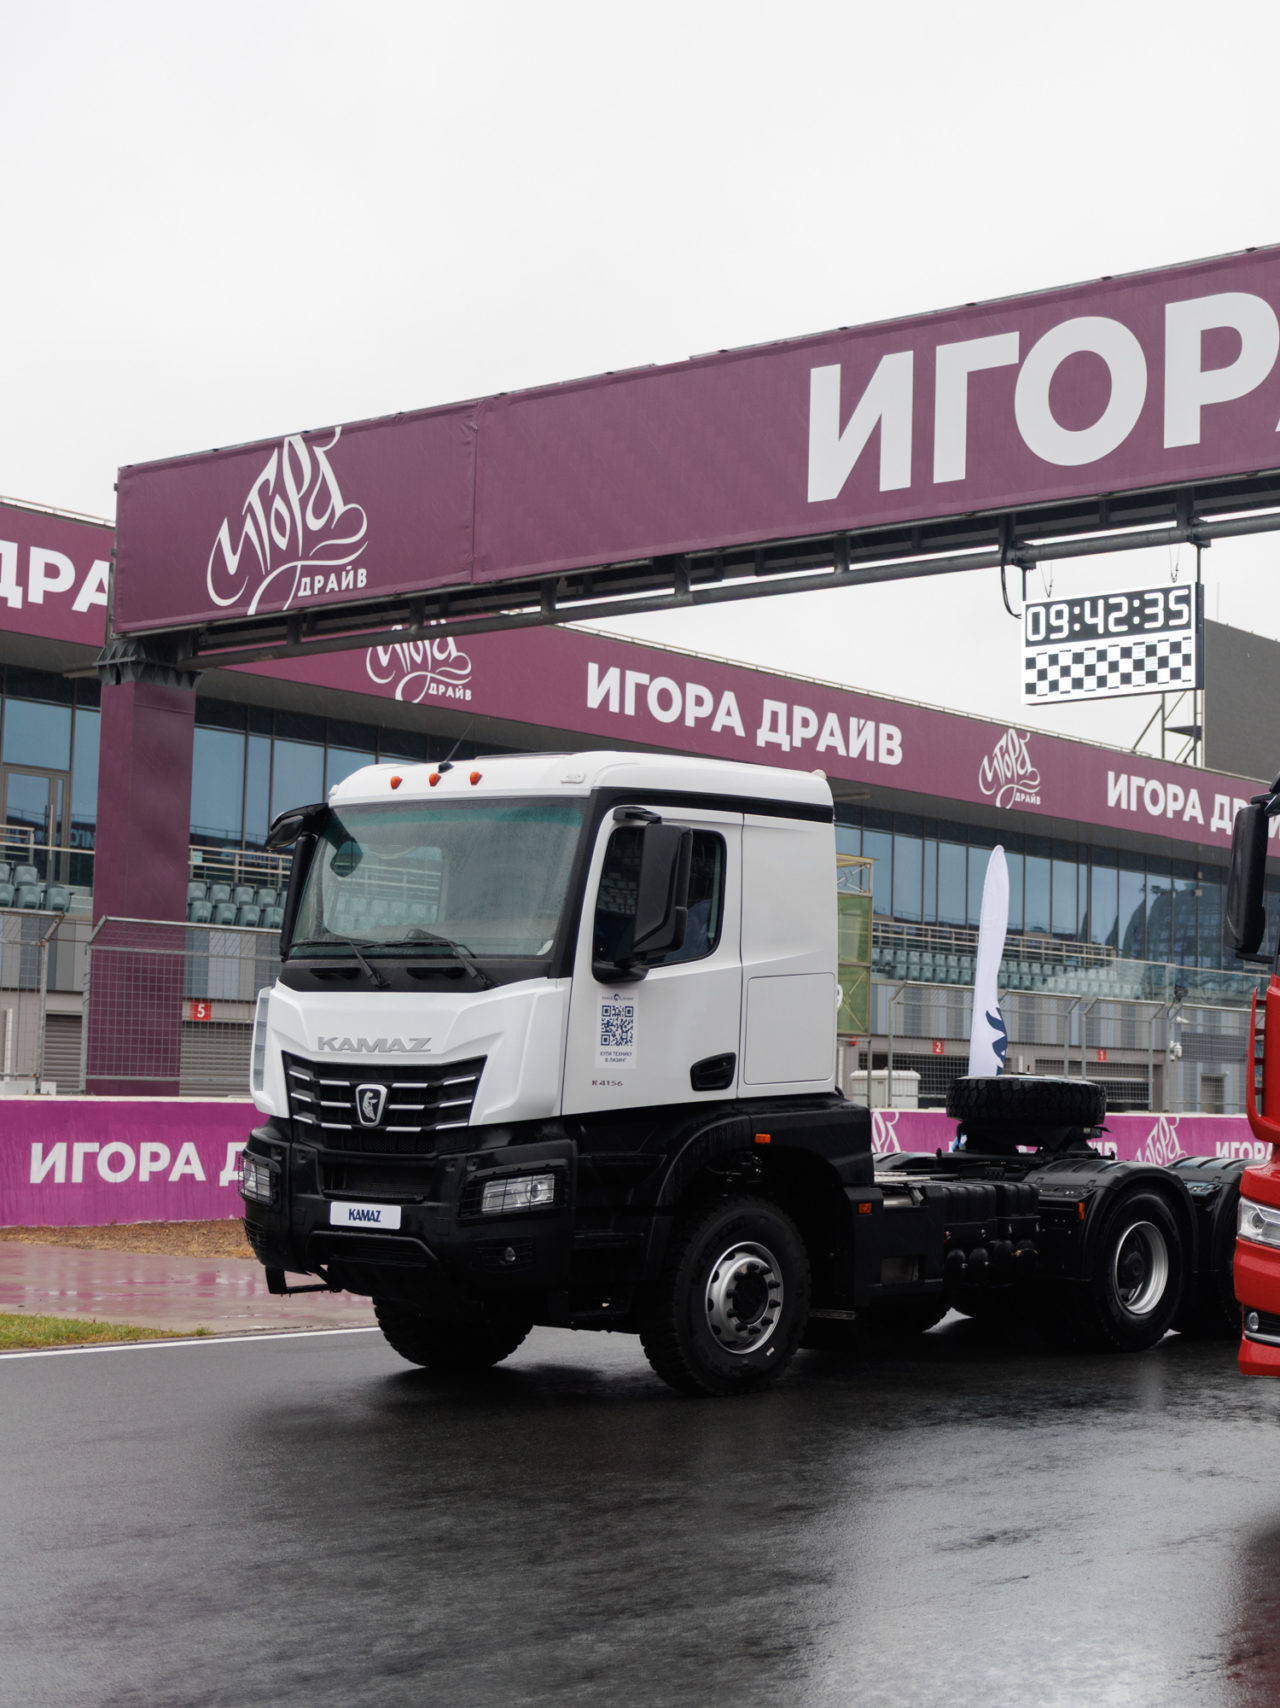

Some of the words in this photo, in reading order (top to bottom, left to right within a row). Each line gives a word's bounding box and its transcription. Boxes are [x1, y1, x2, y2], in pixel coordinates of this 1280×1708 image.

[298, 565, 367, 597] ДРАЙВ
[1027, 589, 1189, 642] 09:42:35
[428, 683, 472, 701] ДРАЙВ
[586, 661, 746, 737] ИГОРА
[756, 698, 903, 766] ДРАЙВ
[1015, 792, 1041, 805] ДРАЙВ
[1107, 770, 1205, 825] ИГОРА
[197, 1003, 206, 1018] 5
[318, 1036, 432, 1053] KAMAZ
[935, 1041, 942, 1053] 2
[29, 1141, 206, 1184] ИГОРА
[348, 1208, 381, 1223] KAMAZ
